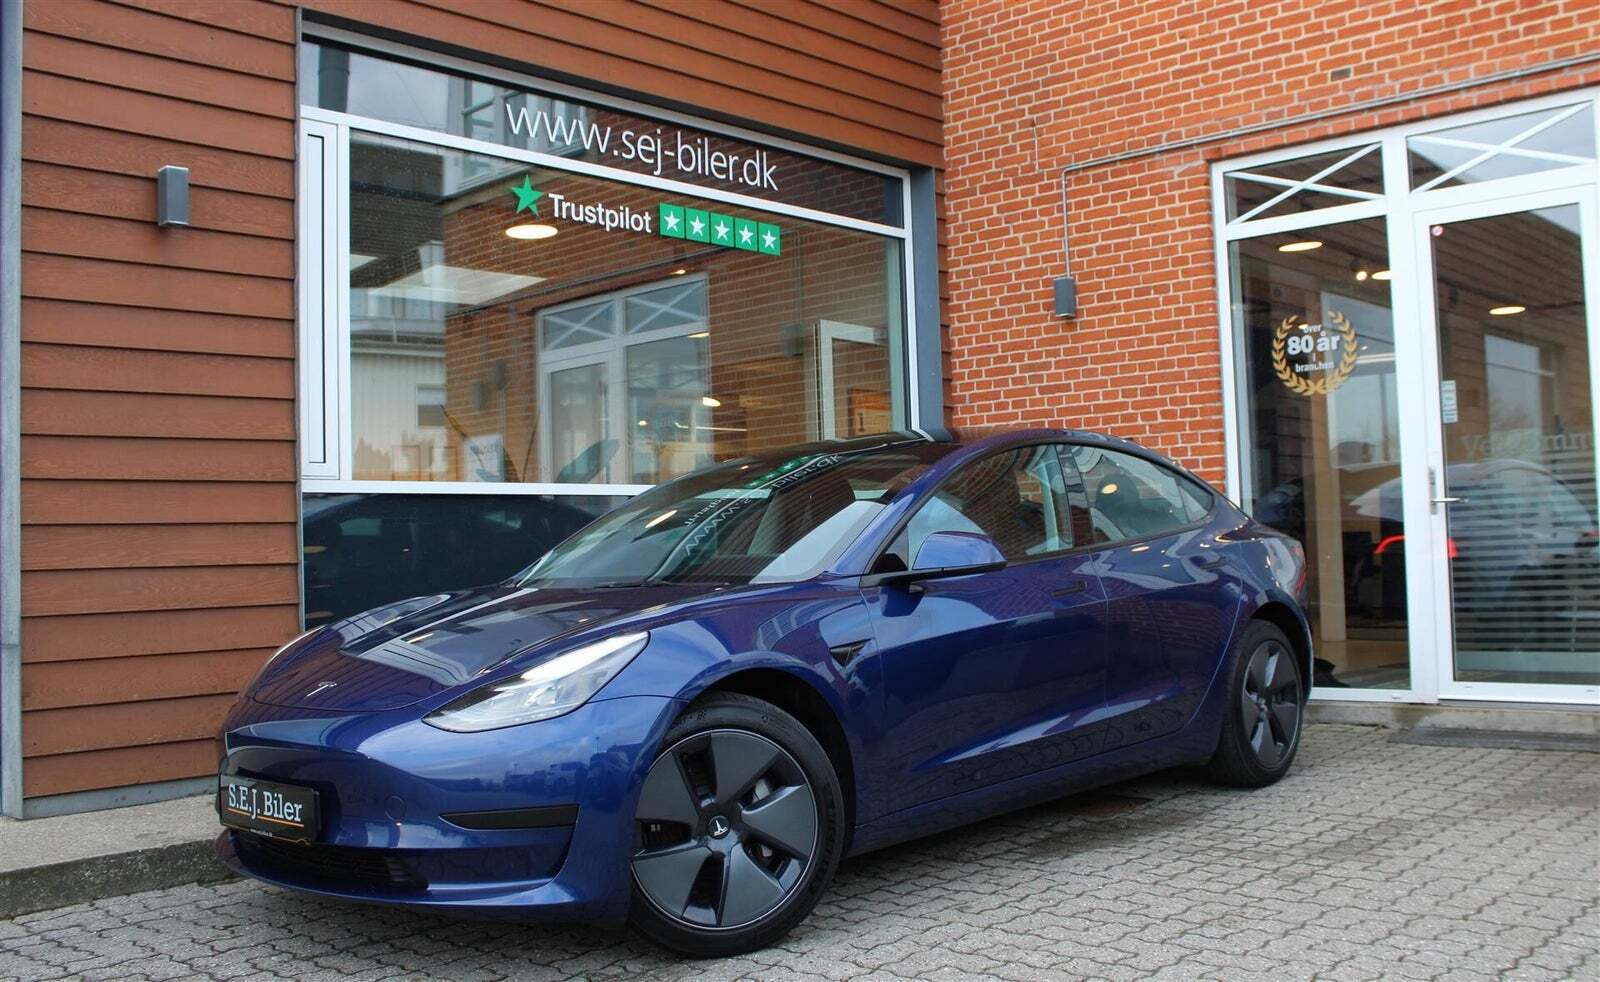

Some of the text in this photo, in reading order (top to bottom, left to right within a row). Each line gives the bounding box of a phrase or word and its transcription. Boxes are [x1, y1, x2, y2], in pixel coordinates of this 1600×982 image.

[506, 103, 779, 191] www.sej-biler.dk
[548, 193, 652, 233] Trustpilot
[1287, 331, 1340, 355] 80 år
[228, 784, 303, 822] S.E.J. Biler
